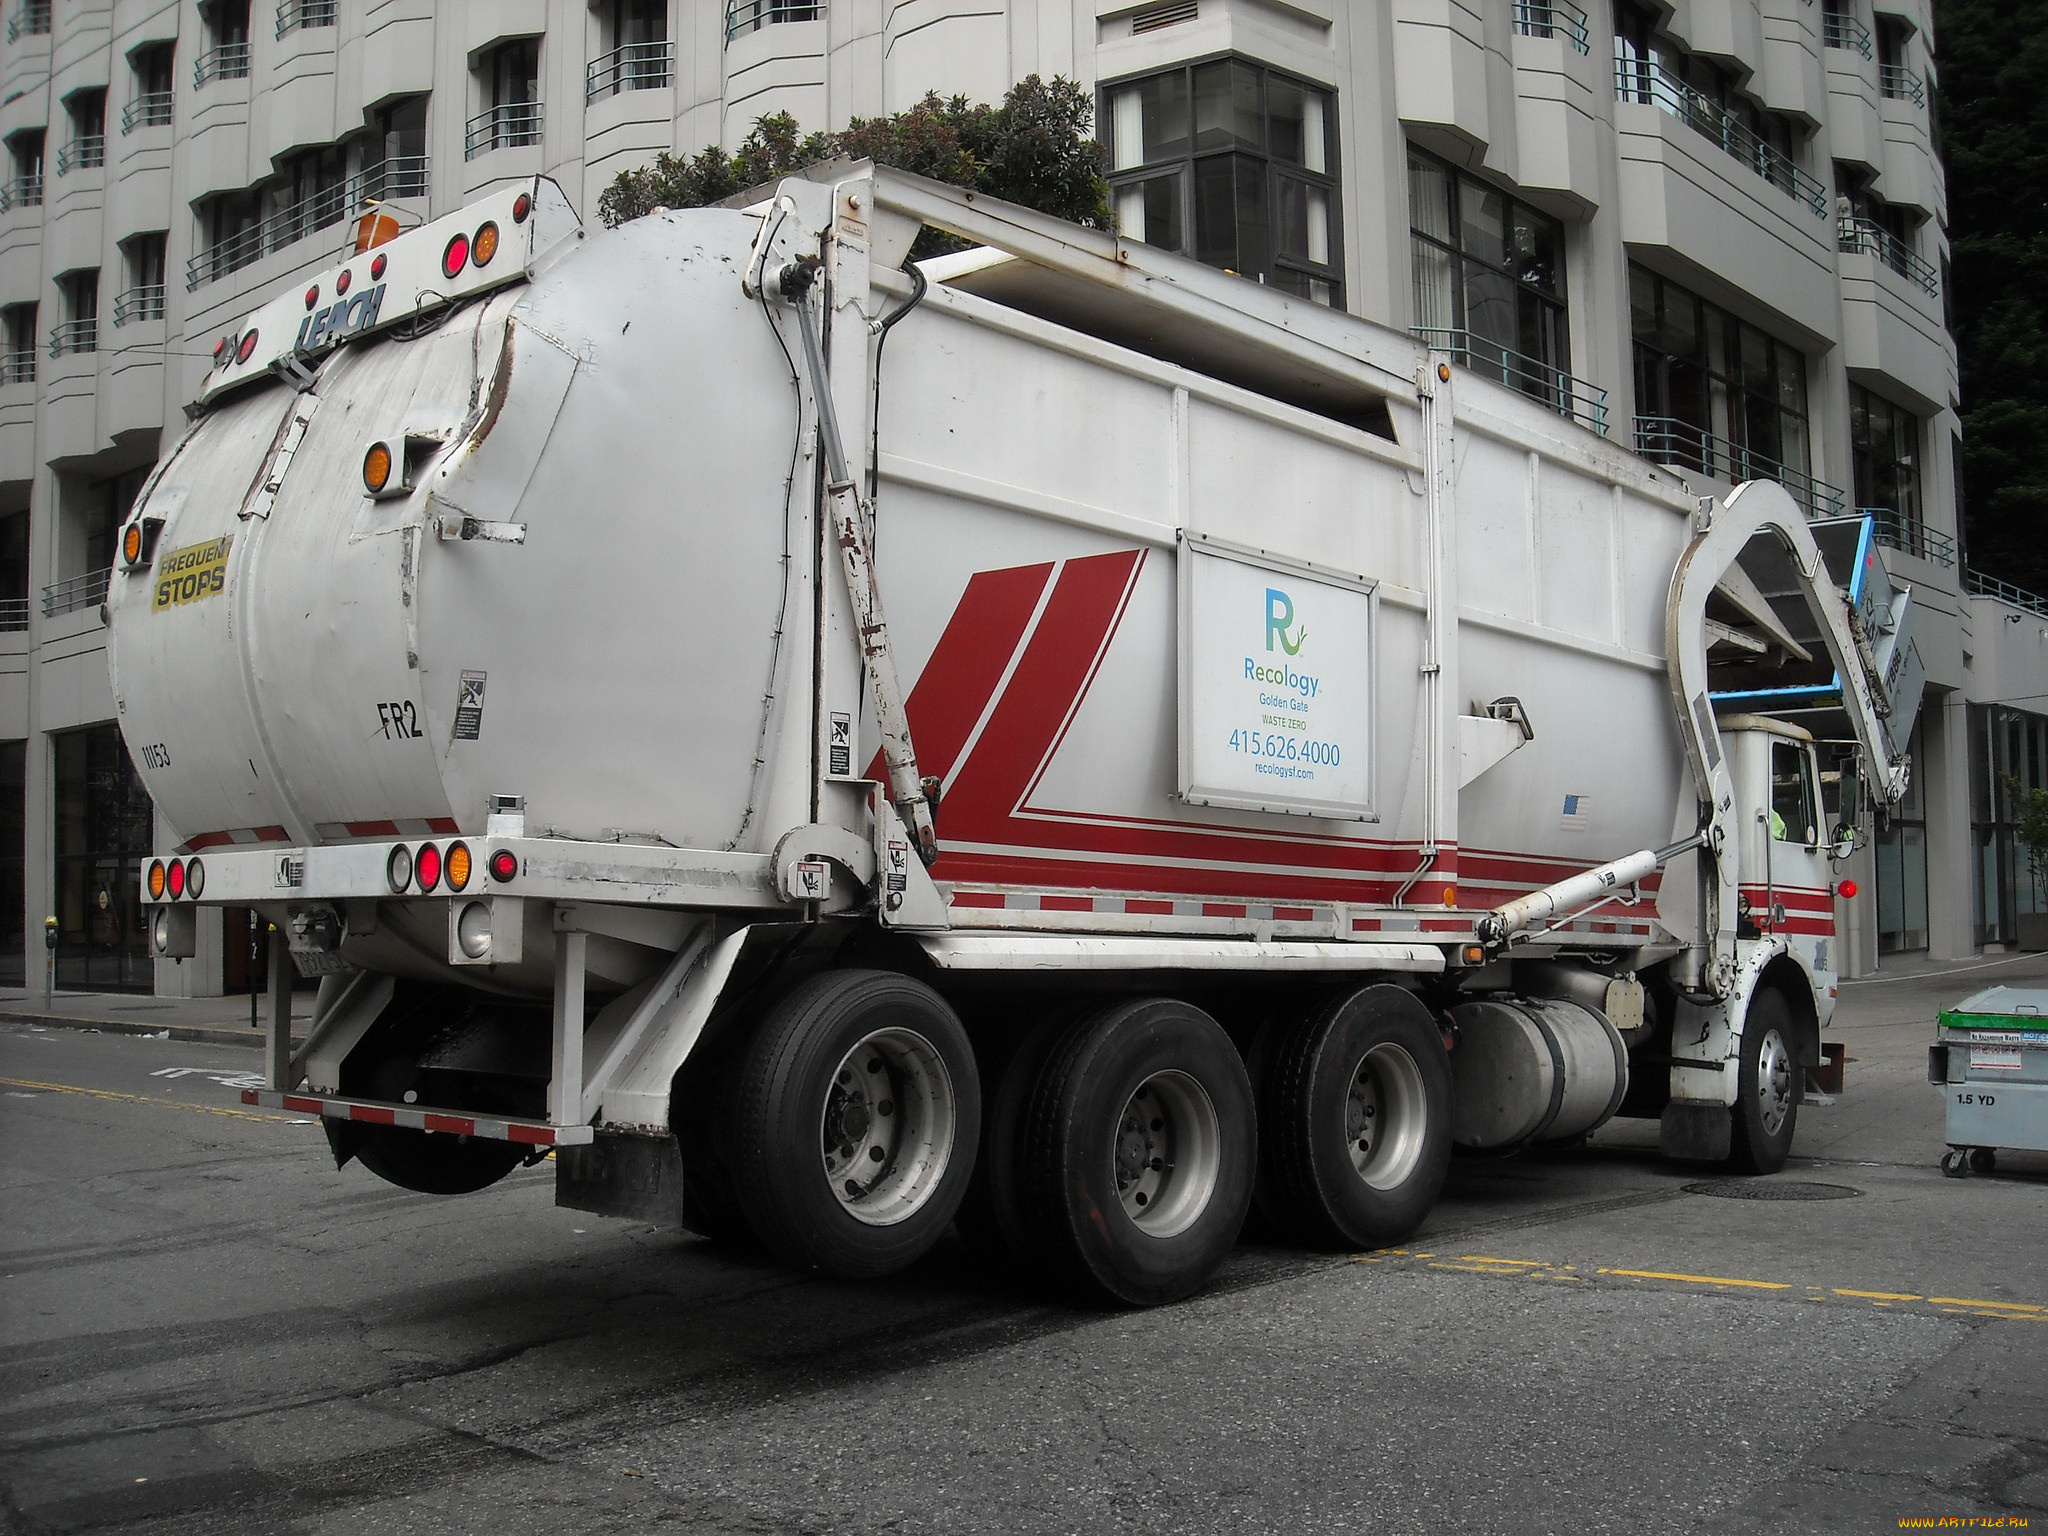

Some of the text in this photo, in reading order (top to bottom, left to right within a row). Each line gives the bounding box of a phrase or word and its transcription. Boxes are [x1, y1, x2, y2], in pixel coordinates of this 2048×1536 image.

[293, 283, 387, 351] LEACH
[158, 566, 225, 606] STOPS
[1265, 587, 1308, 656] R
[1244, 657, 1319, 698] Recology
[1886, 648, 1902, 693] 7886
[377, 700, 423, 740] FR2
[1259, 692, 1309, 713] Golden Gate
[1262, 714, 1307, 731] WASTE ZERO
[142, 743, 171, 770] 11153
[1229, 728, 1340, 767] 415.626.4000
[1255, 763, 1314, 780] recologysf.com
[1957, 1093, 1995, 1106] 1.5 YD
